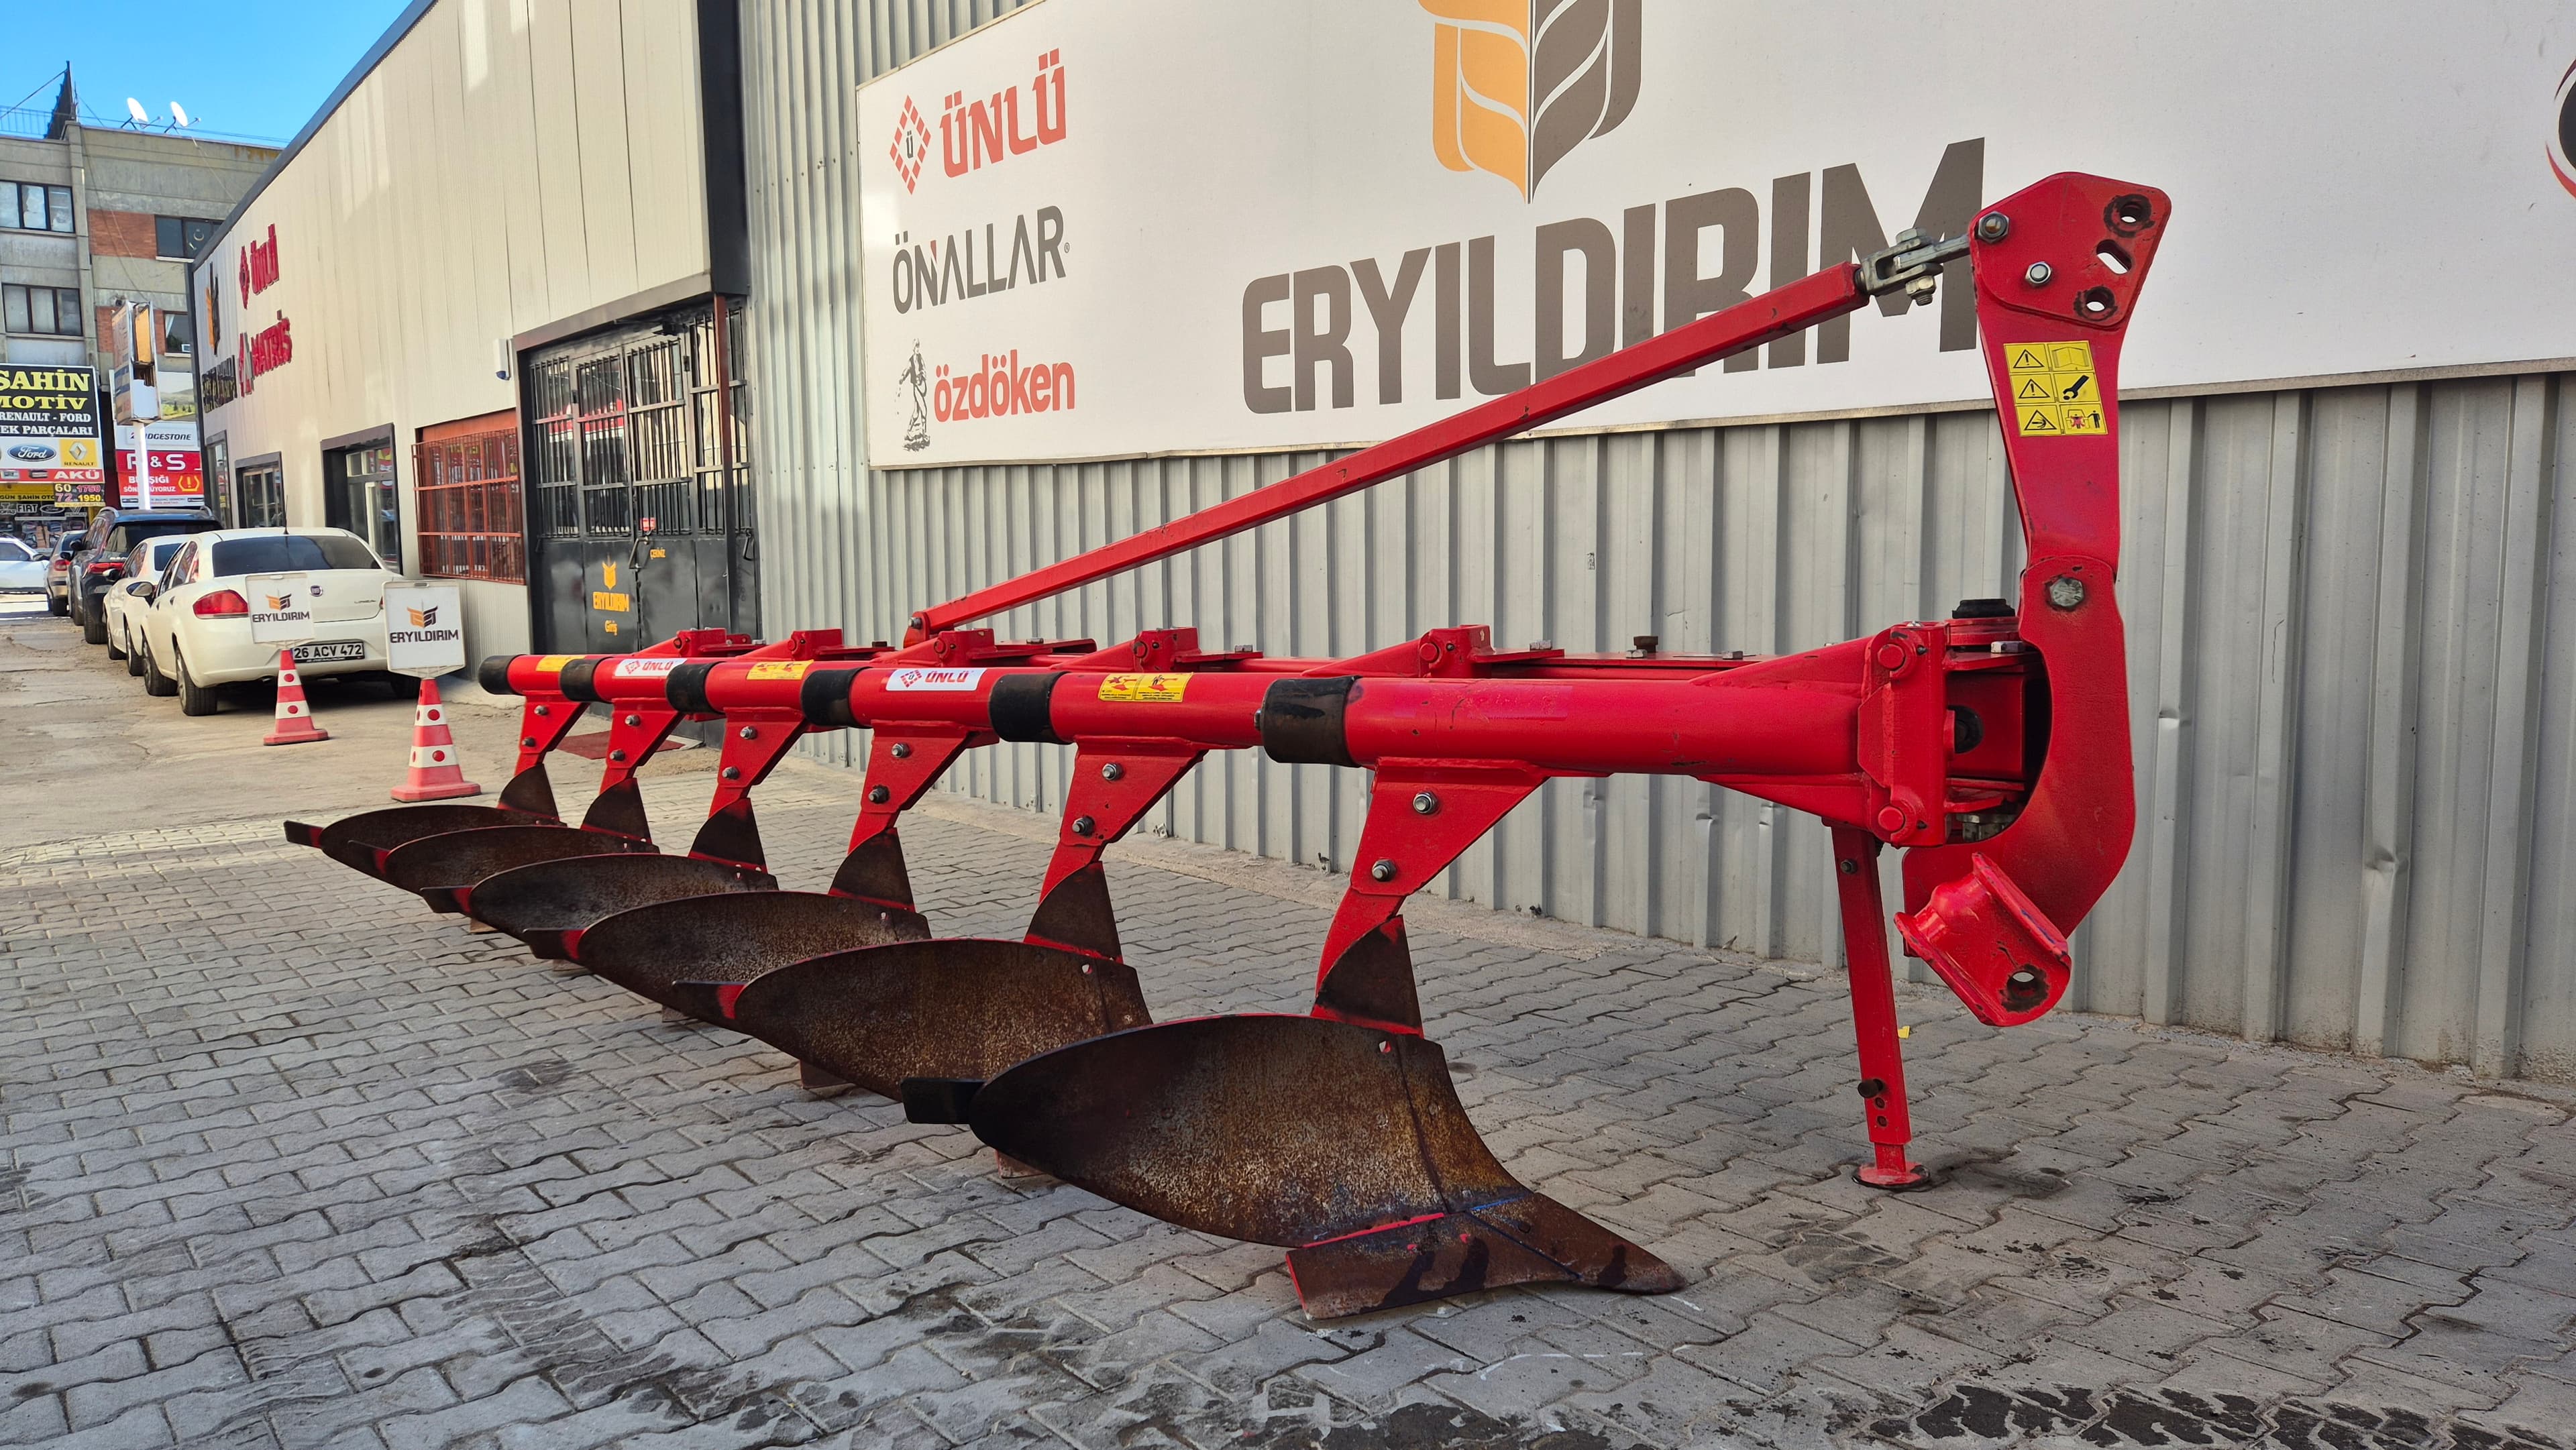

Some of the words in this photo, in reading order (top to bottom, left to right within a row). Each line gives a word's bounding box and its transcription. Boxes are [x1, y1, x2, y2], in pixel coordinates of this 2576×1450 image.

[939, 48, 1067, 178] ÜNLÜ
[1242, 137, 1985, 414] ERYILDIRIM
[934, 349, 1075, 423] özdöken
[59, 413, 91, 423] FORD
[21, 426, 93, 437] PARÇALARI
[17, 445, 48, 459] Ford
[150, 455, 162, 468] &
[166, 453, 186, 471] S
[54, 470, 100, 480] AKÜ
[54, 484, 72, 492] 60
[55, 492, 73, 502] 72
[17, 504, 38, 512] FIAT
[252, 611, 311, 623] ERYILDIRIM
[389, 629, 460, 644] ERYILDIRIM
[294, 647, 309, 658] 26
[313, 646, 337, 657] ACV
[340, 644, 362, 655] 472
[924, 670, 969, 683] ÜNLÜ
